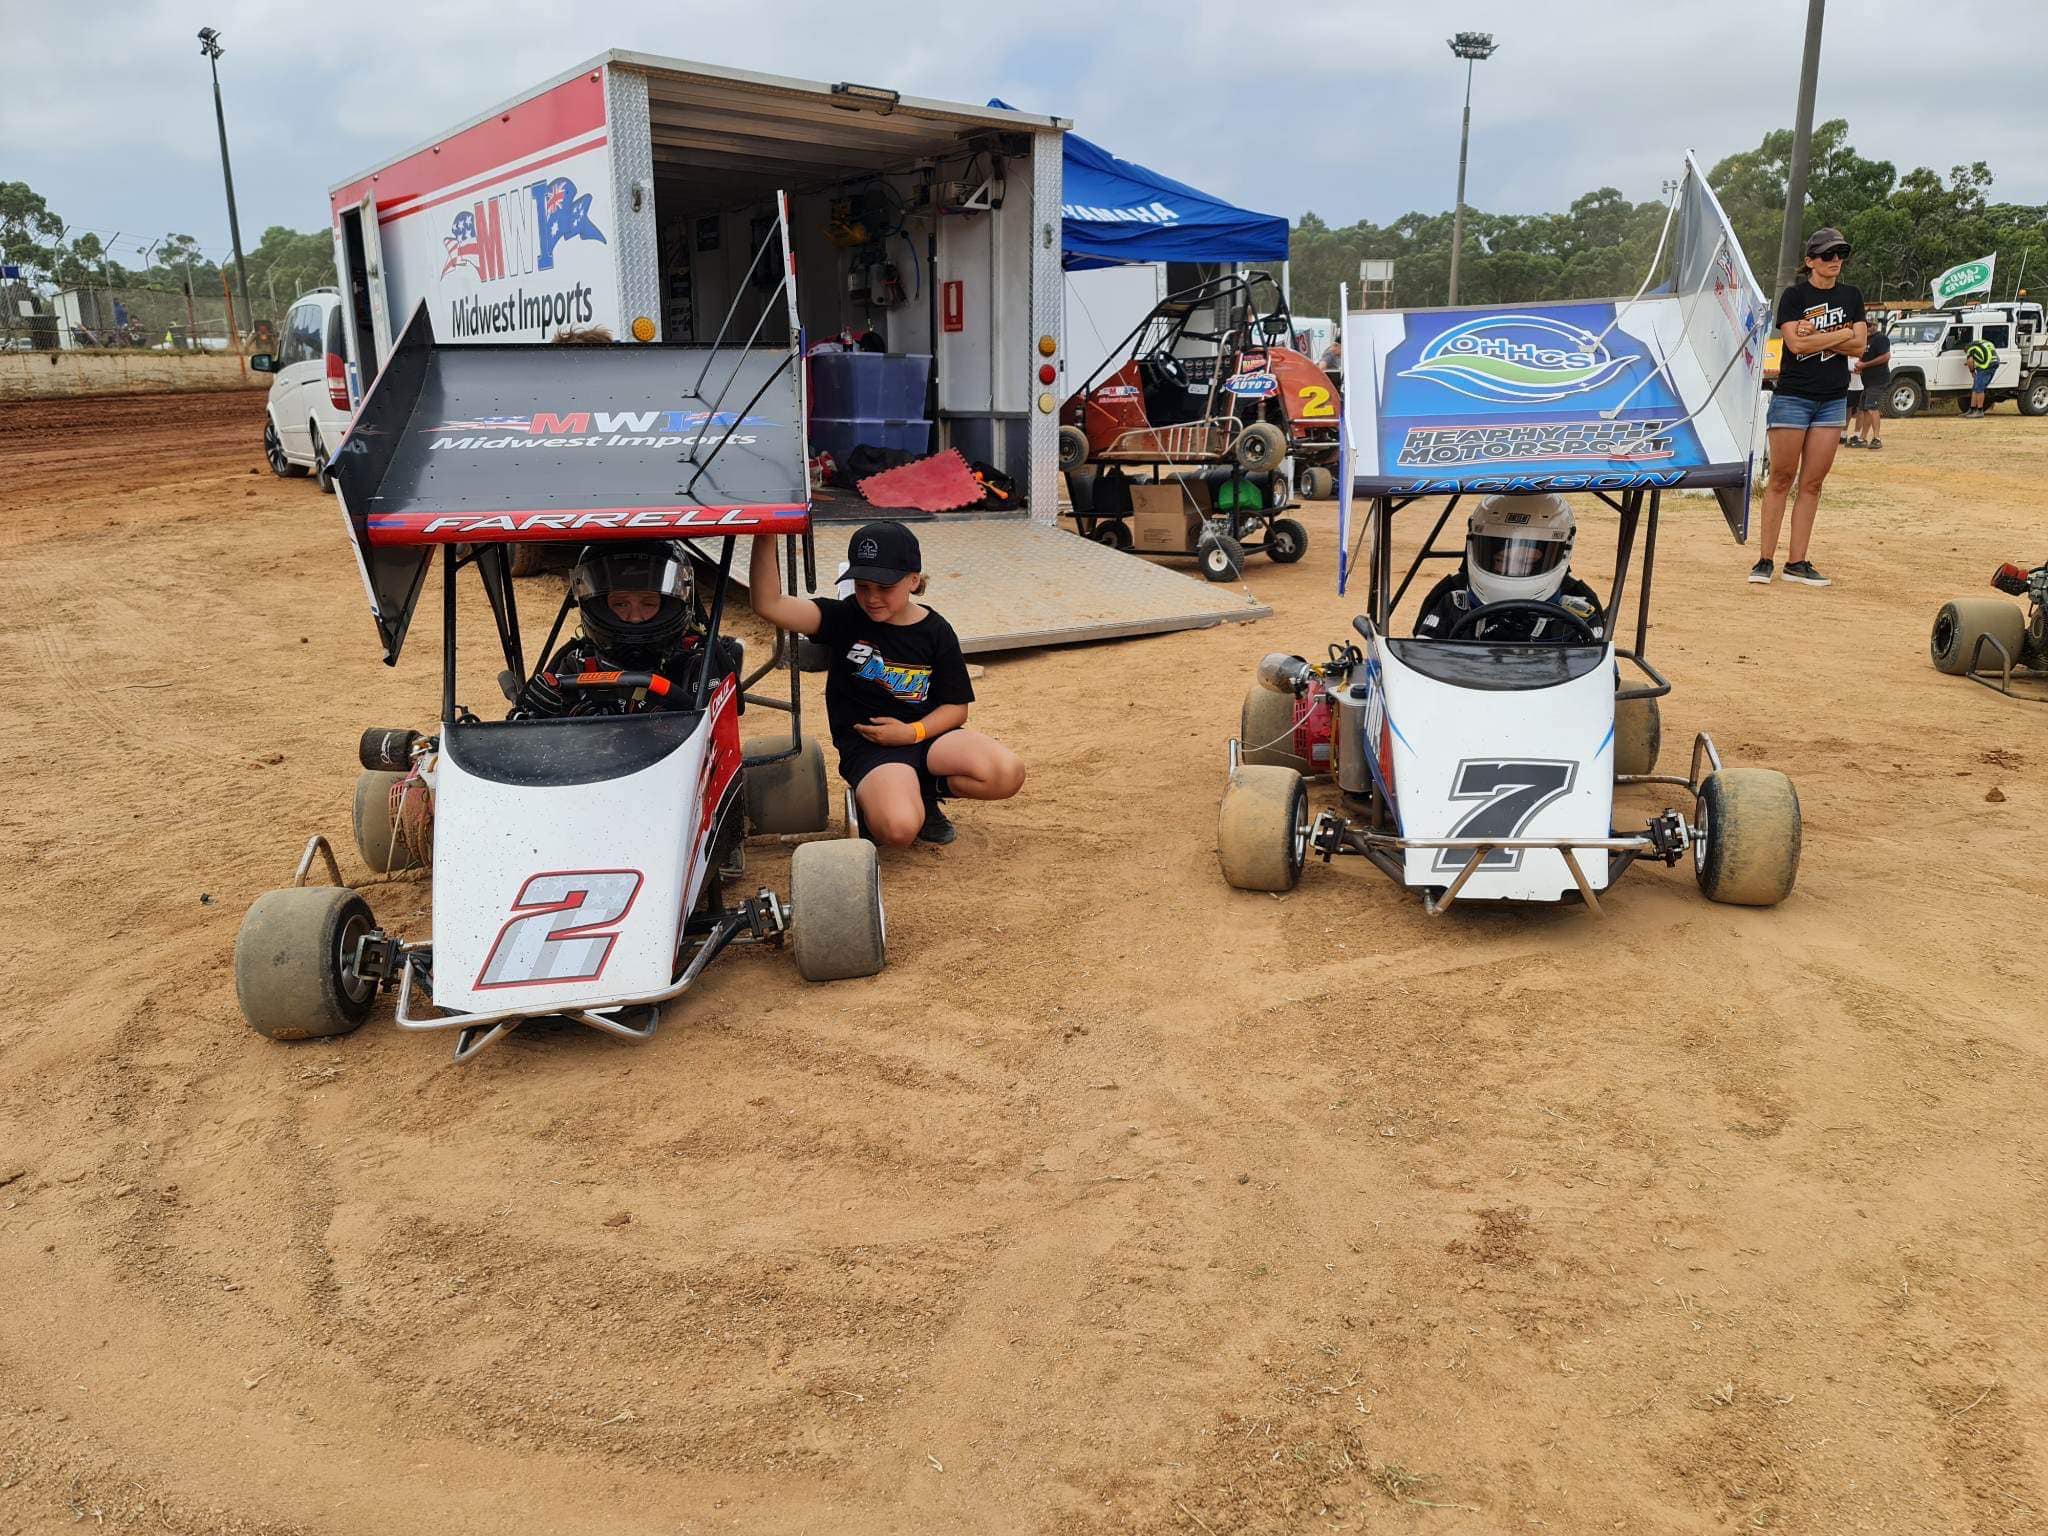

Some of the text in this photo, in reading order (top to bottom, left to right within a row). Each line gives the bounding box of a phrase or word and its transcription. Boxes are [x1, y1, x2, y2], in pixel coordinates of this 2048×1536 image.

[452, 281, 593, 339] Midwest Imports
[1450, 334, 1592, 369] OHHCS
[1299, 385, 1335, 416] 2
[428, 434, 758, 451] Midwest Imports
[1398, 437, 1672, 463] MOTORSPORT
[1405, 427, 1568, 448] HEAPHY
[1389, 471, 1686, 494] JACKSON
[422, 509, 760, 533] FARRELL
[846, 643, 874, 665] 2
[1433, 758, 1580, 872] 7
[473, 869, 644, 990] 2
